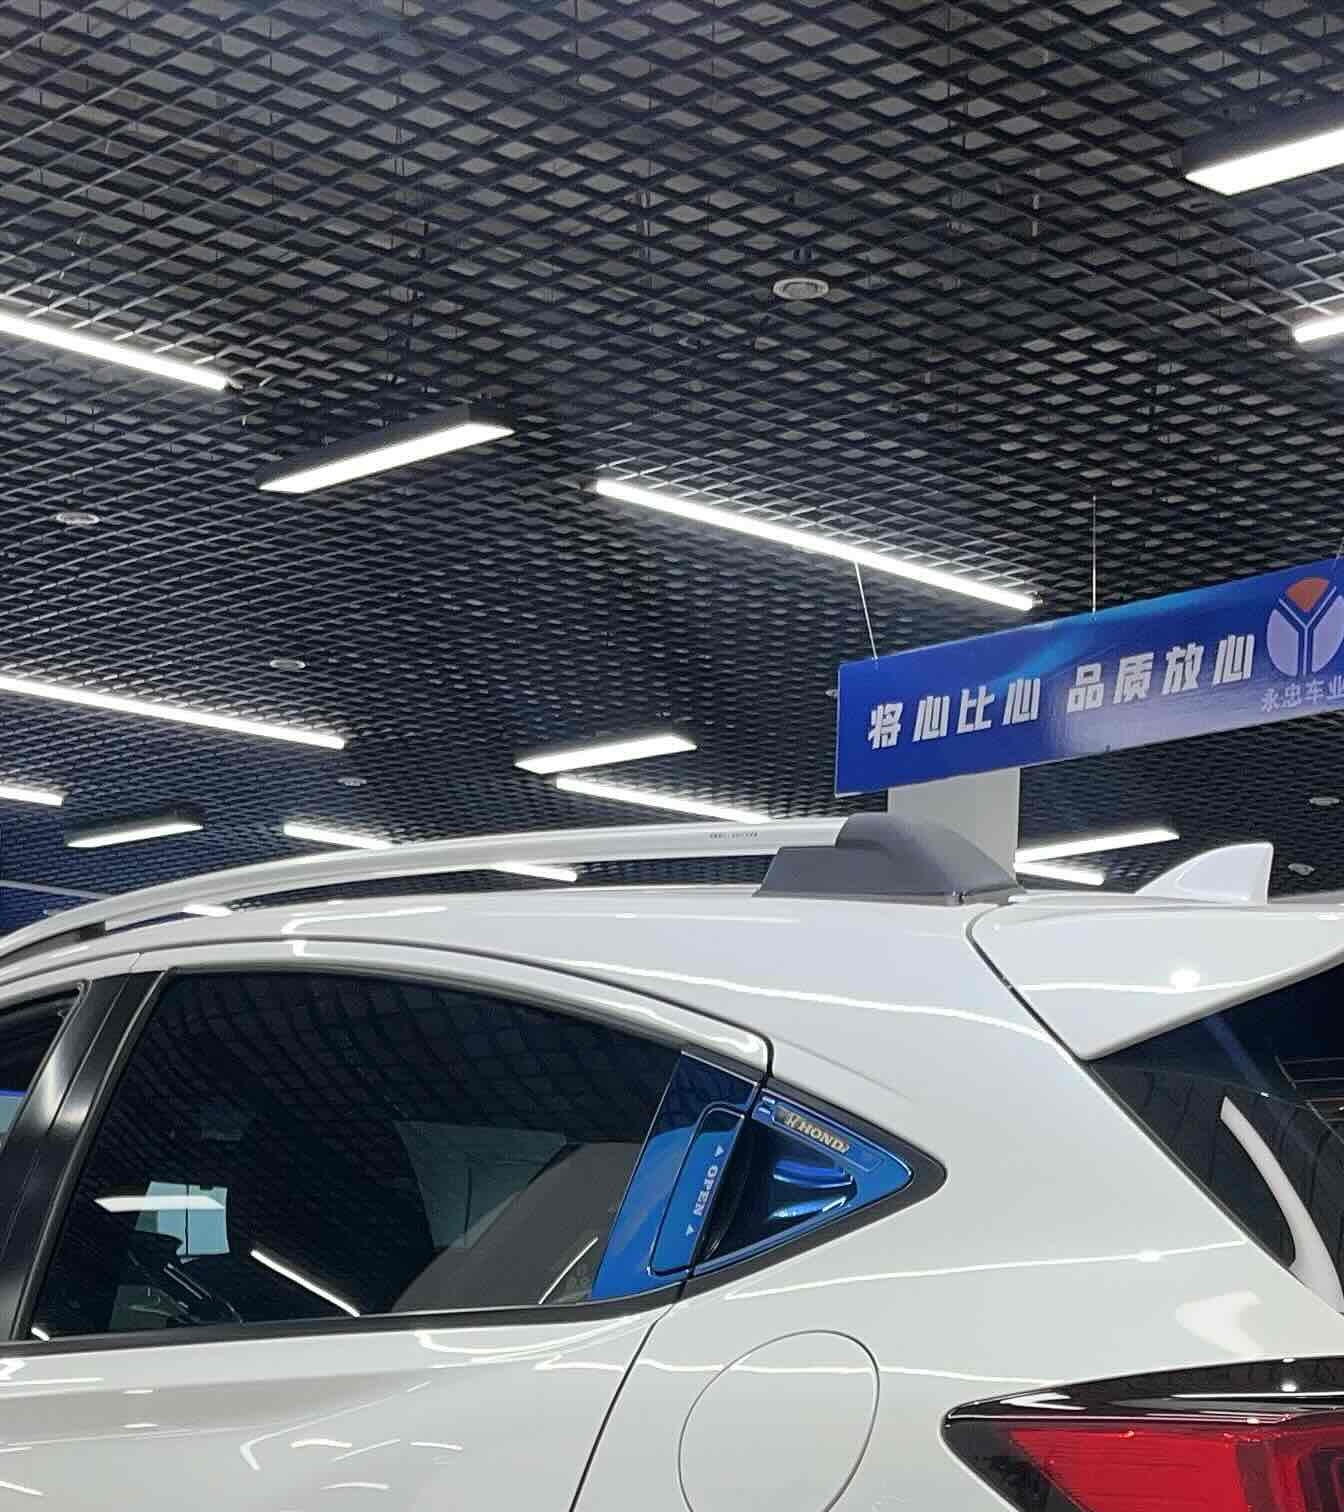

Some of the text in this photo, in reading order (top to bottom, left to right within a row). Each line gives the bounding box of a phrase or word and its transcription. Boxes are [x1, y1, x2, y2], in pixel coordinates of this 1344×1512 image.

[867, 633, 1256, 750] 将心比心 品质放心
[693, 1165, 719, 1217] OPEN
